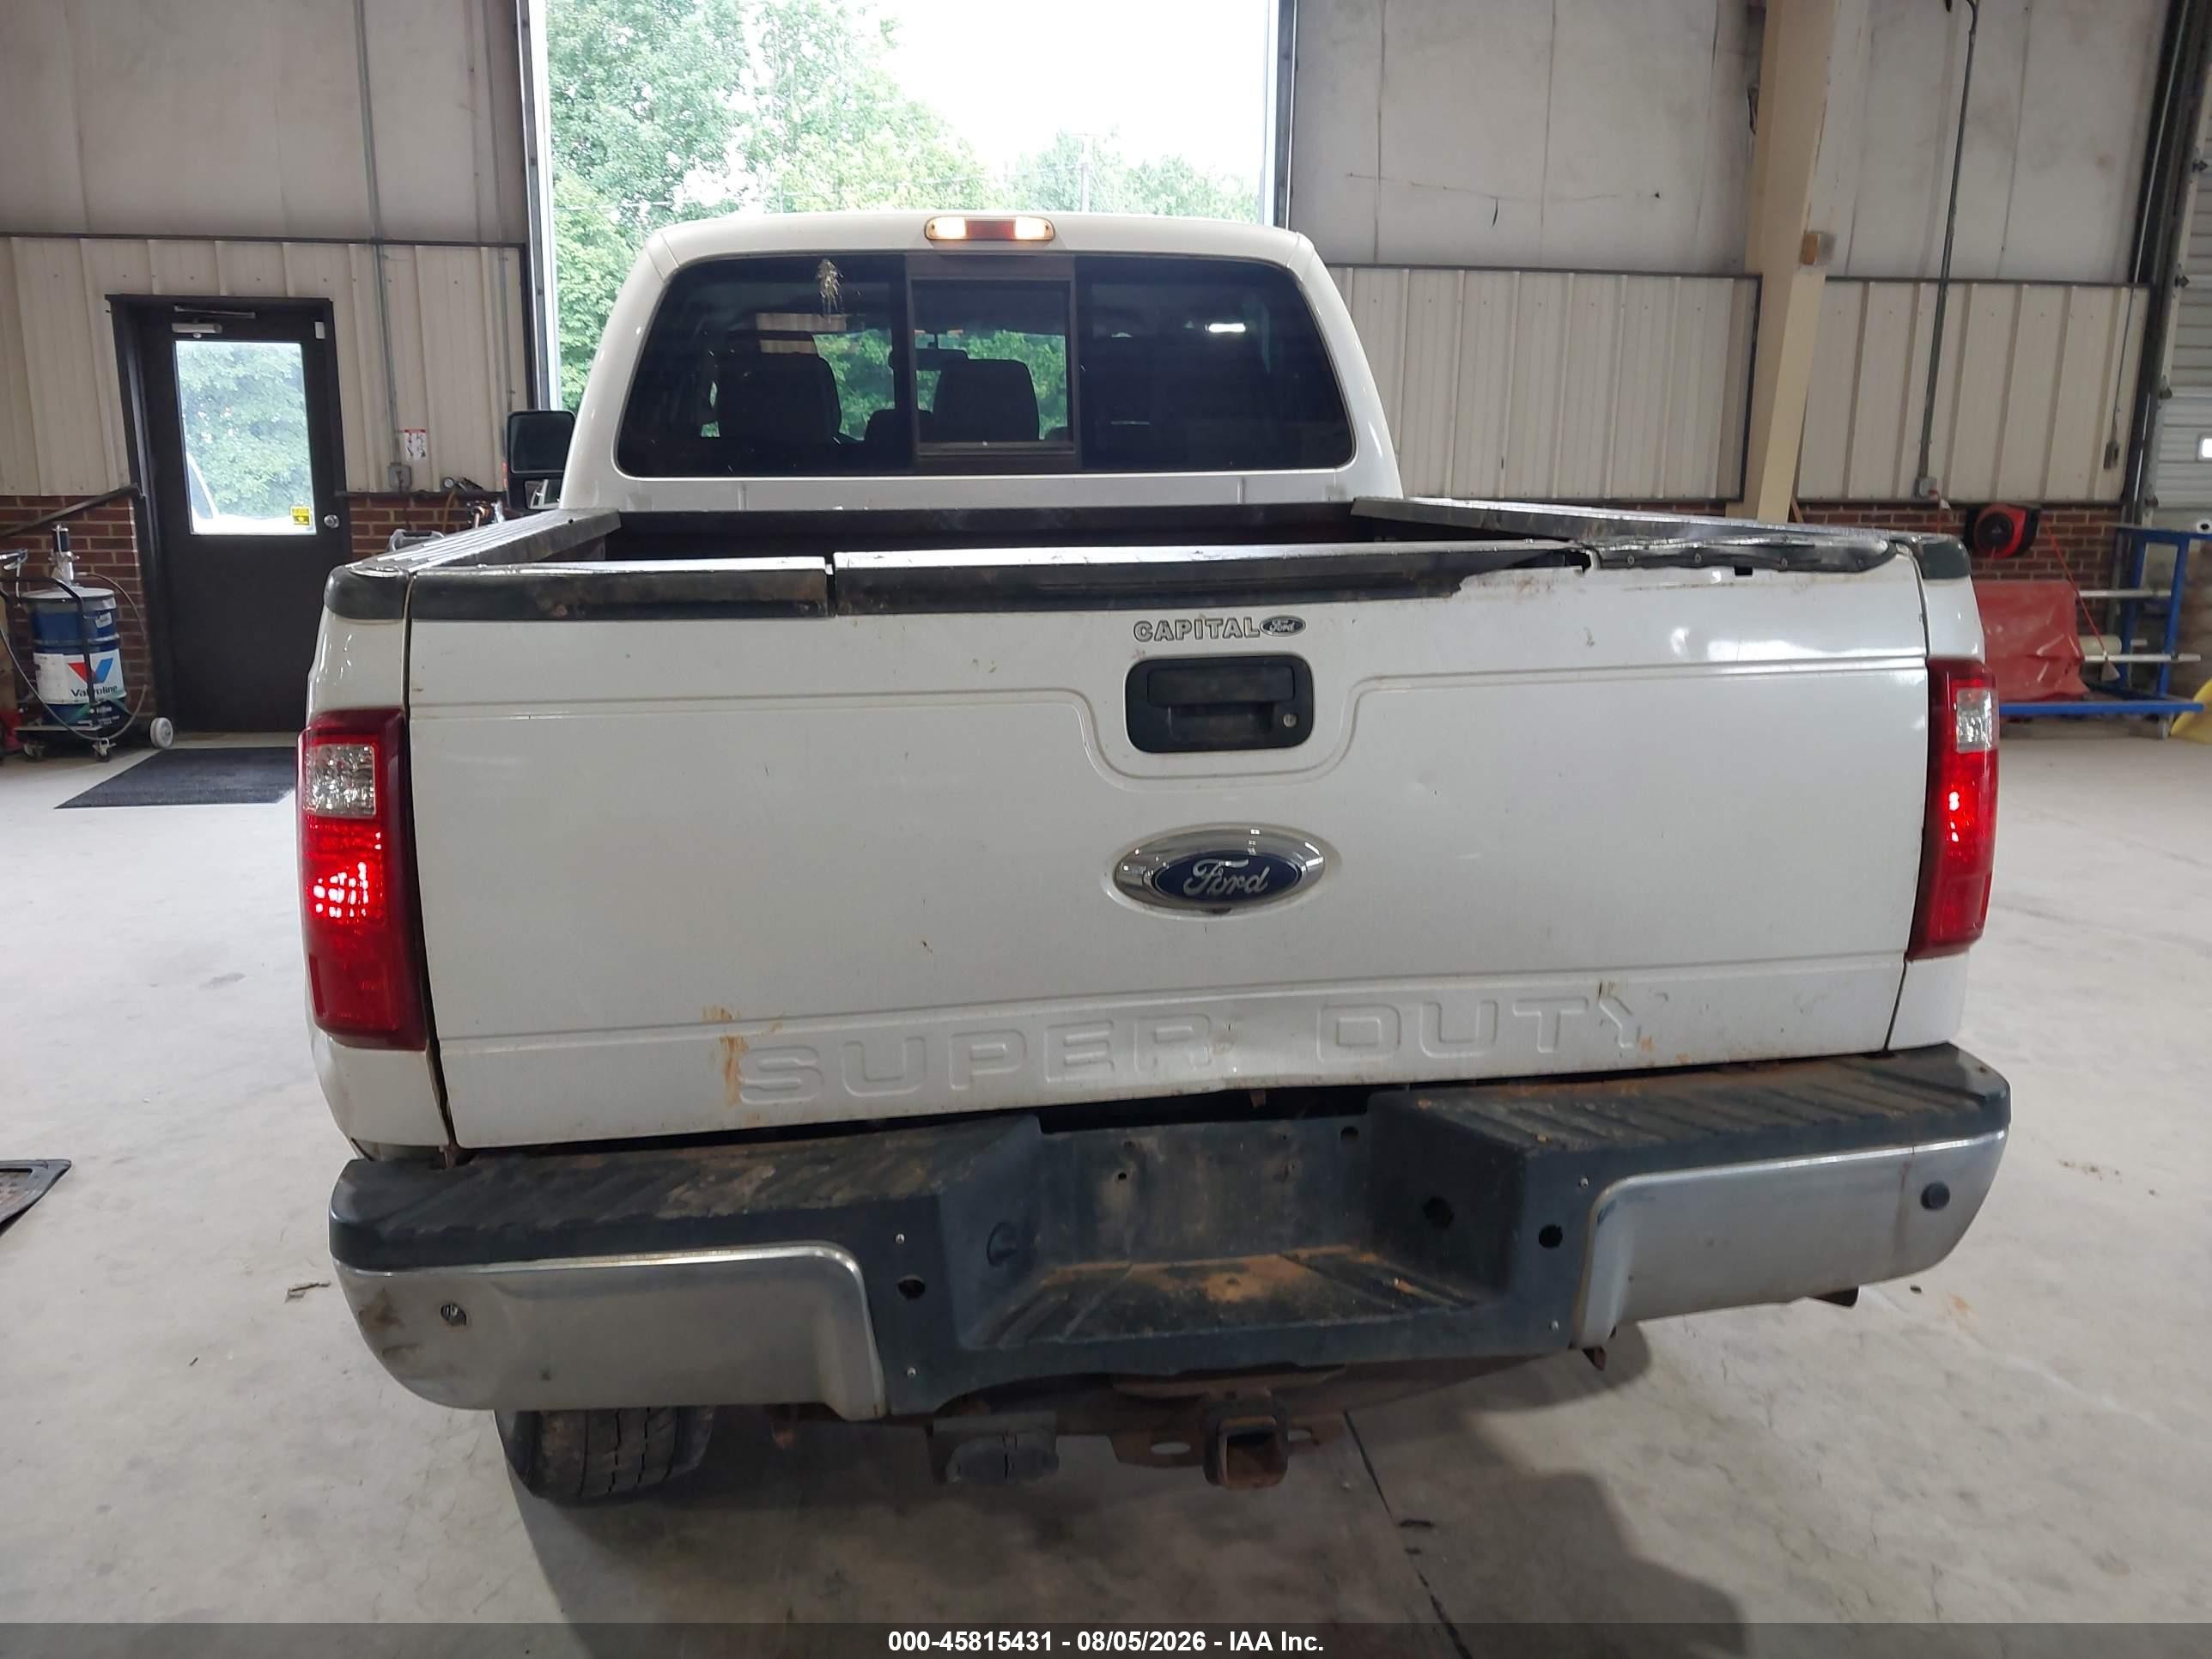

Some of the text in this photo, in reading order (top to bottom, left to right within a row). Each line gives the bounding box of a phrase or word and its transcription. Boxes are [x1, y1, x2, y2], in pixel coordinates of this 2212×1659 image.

[1133, 617, 1260, 641] CAPITAL
[70, 685, 118, 697] Vaoline
[1182, 859, 1270, 896] Ford
[739, 991, 1668, 1105] SUPER DUTY
